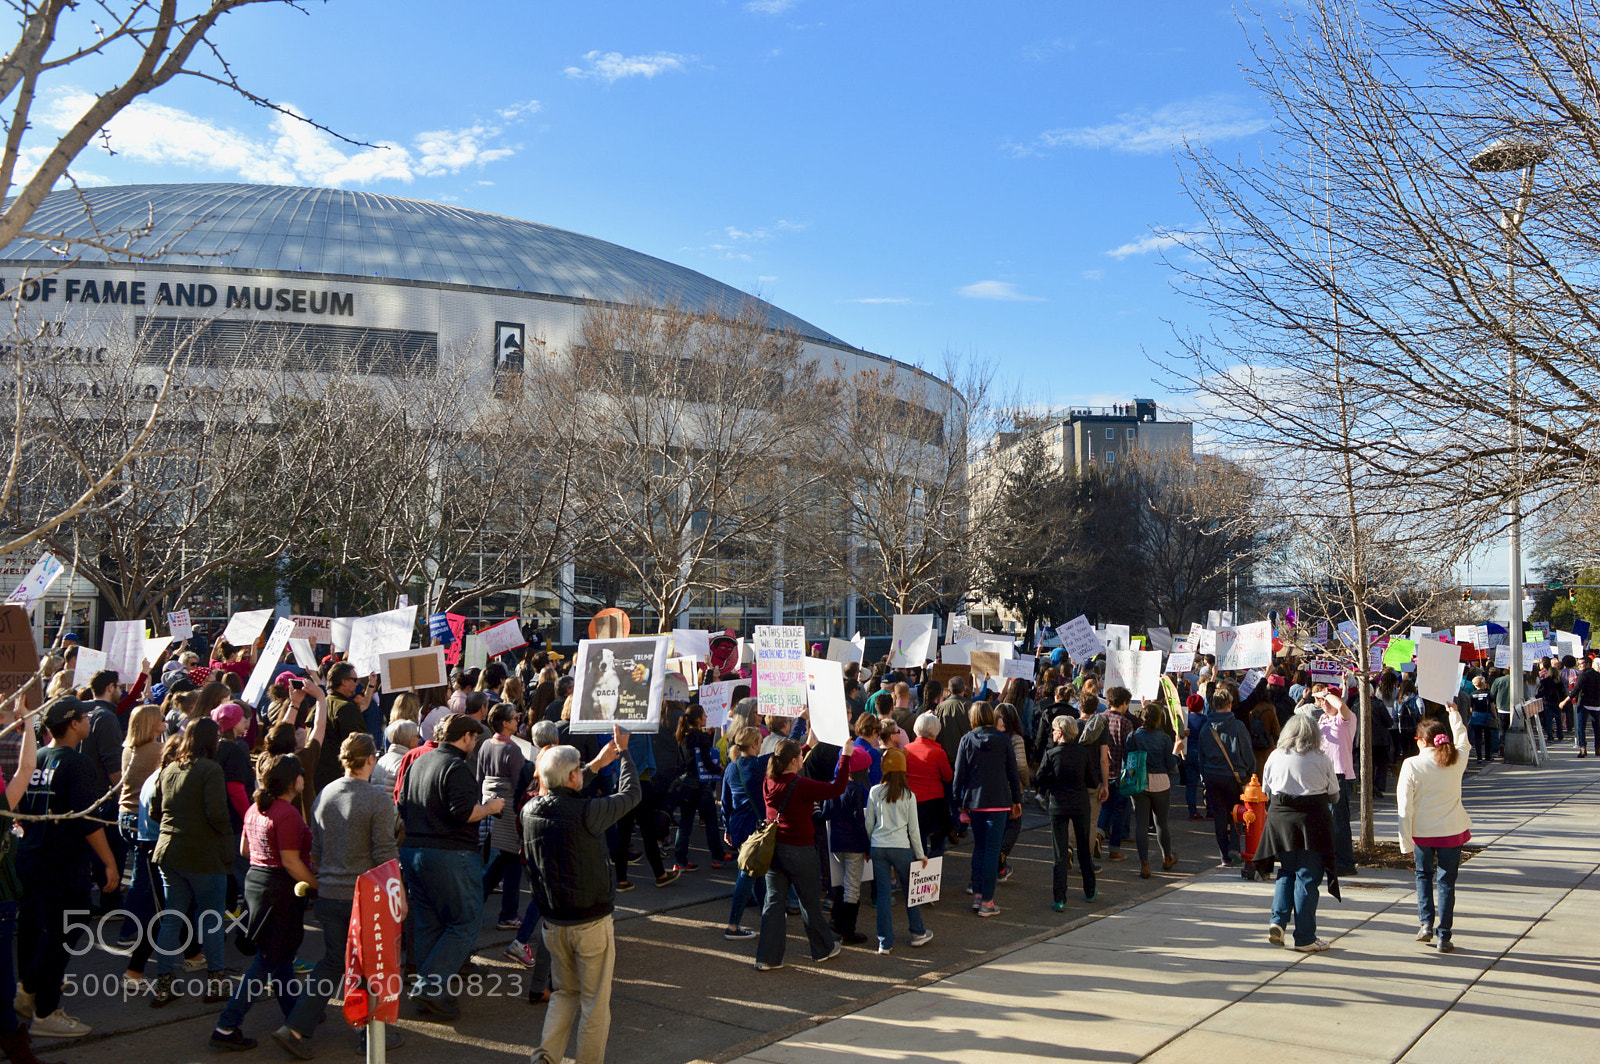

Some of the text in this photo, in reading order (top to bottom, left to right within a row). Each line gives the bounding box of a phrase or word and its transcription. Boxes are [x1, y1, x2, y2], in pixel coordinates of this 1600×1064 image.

[21, 278, 57, 302] OF
[65, 279, 146, 305] FAME
[156, 282, 218, 307] AND
[226, 285, 354, 317] MUSEUM
[292, 617, 331, 629] SHITHOLE
[766, 626, 781, 638] THIS
[782, 627, 803, 638] HOUSE
[760, 638, 799, 649] WE BELIEVE
[634, 653, 653, 661] TRUMP
[596, 689, 616, 697] DACA
[700, 683, 727, 698] LOVE
[786, 694, 804, 706] REAL
[760, 703, 777, 715] LOVE
[911, 870, 920, 878] THE
[914, 873, 940, 885] GOVERNMENT
[373, 884, 381, 902] NO
[373, 913, 385, 980] PARKING
